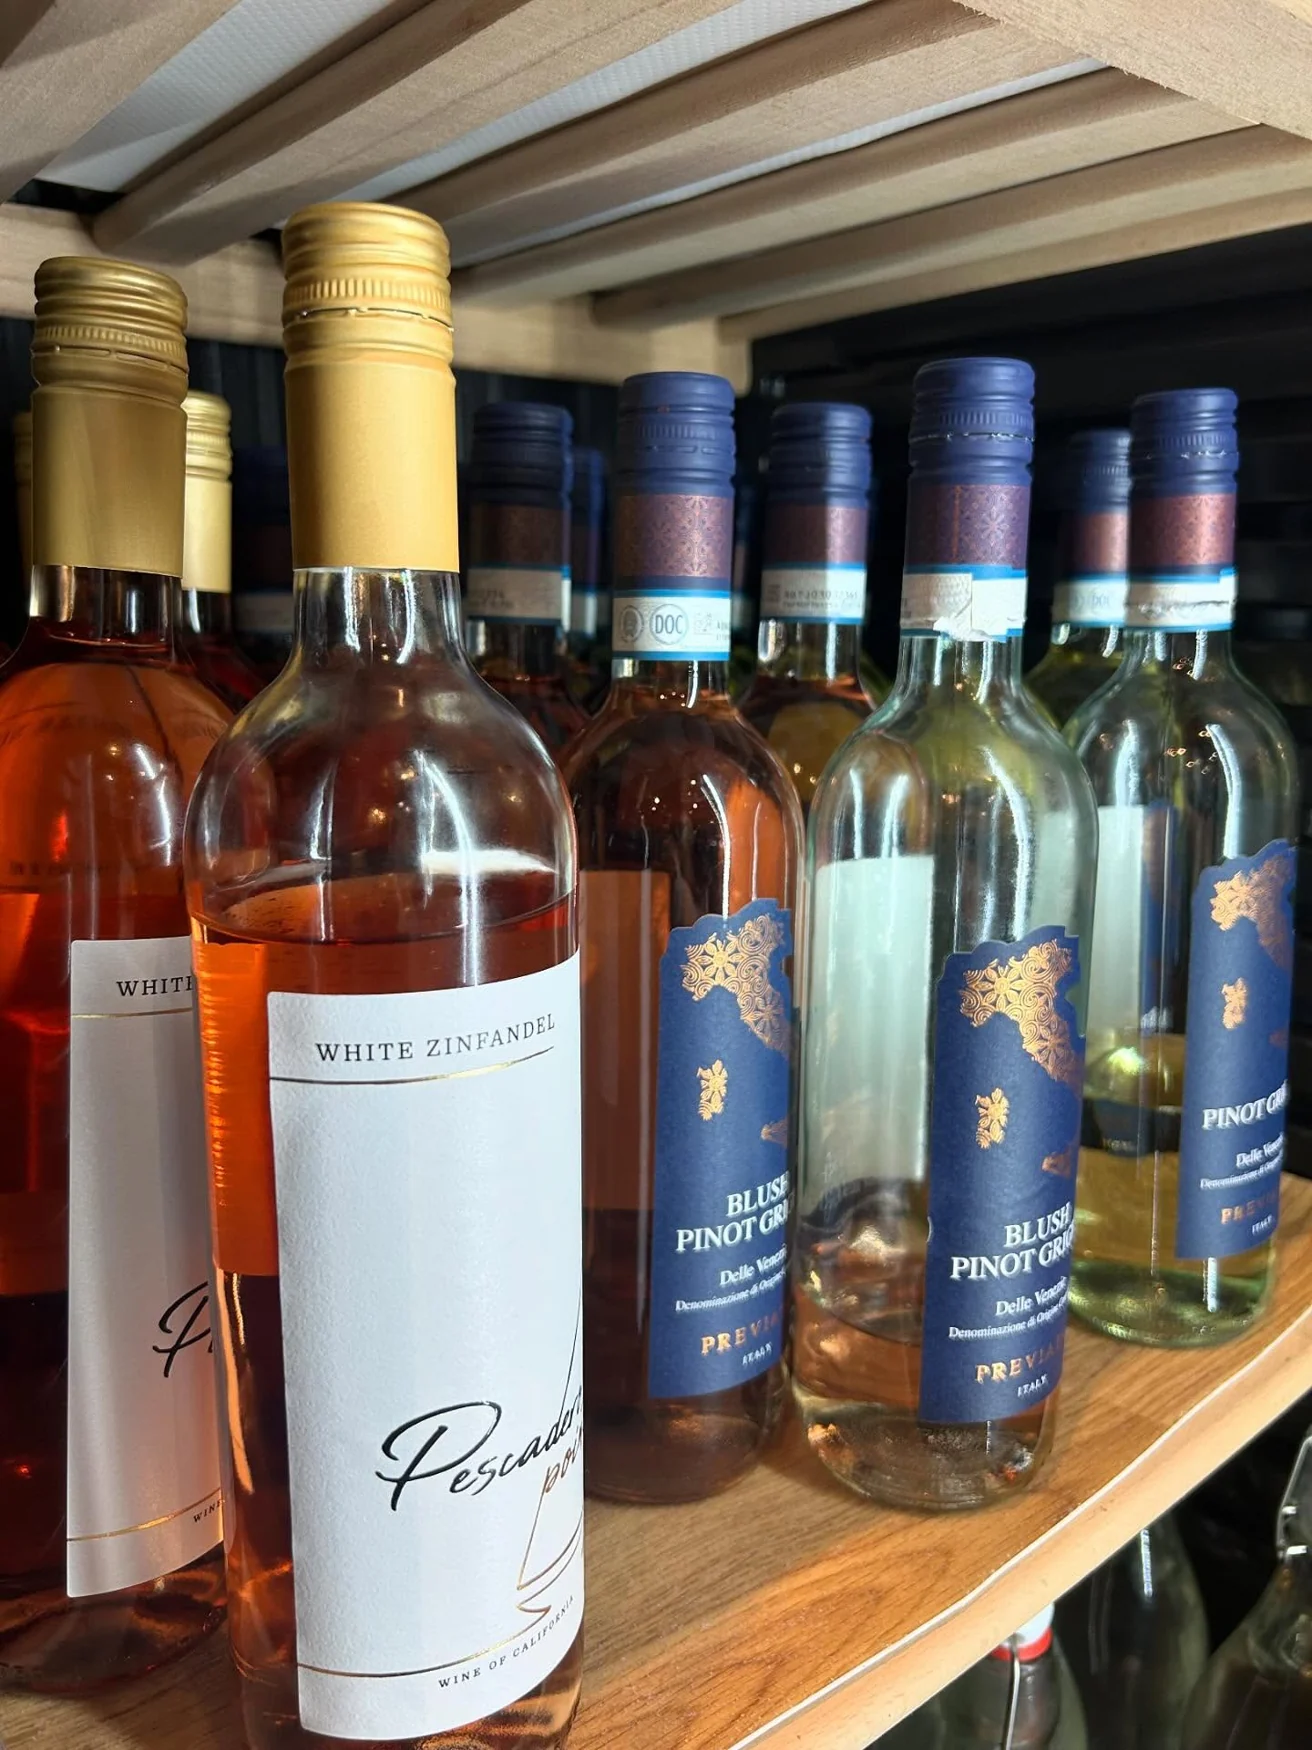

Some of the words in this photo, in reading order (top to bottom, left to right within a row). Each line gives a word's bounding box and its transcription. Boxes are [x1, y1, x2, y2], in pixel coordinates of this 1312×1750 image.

[655, 614, 684, 634] DOC
[316, 1041, 414, 1063] WHITE
[426, 1012, 555, 1058] ZINFANDEL
[1202, 1097, 1267, 1131] PINOT
[676, 1216, 757, 1252] PINOT
[1004, 1201, 1070, 1248] BLUSH
[719, 1264, 755, 1288] Delle
[950, 1248, 1037, 1279] PINOT
[675, 1289, 750, 1313] Denominazione
[995, 1295, 1034, 1317] Delle
[949, 1321, 1027, 1339] Denominazione
[742, 1343, 772, 1366] ITALY
[1017, 1373, 1048, 1397] ITALY
[375, 1385, 582, 1512] Pescader
[438, 1667, 481, 1688] WINE
[489, 1654, 507, 1672] OF
[512, 1595, 574, 1658] CALIFORNIA
